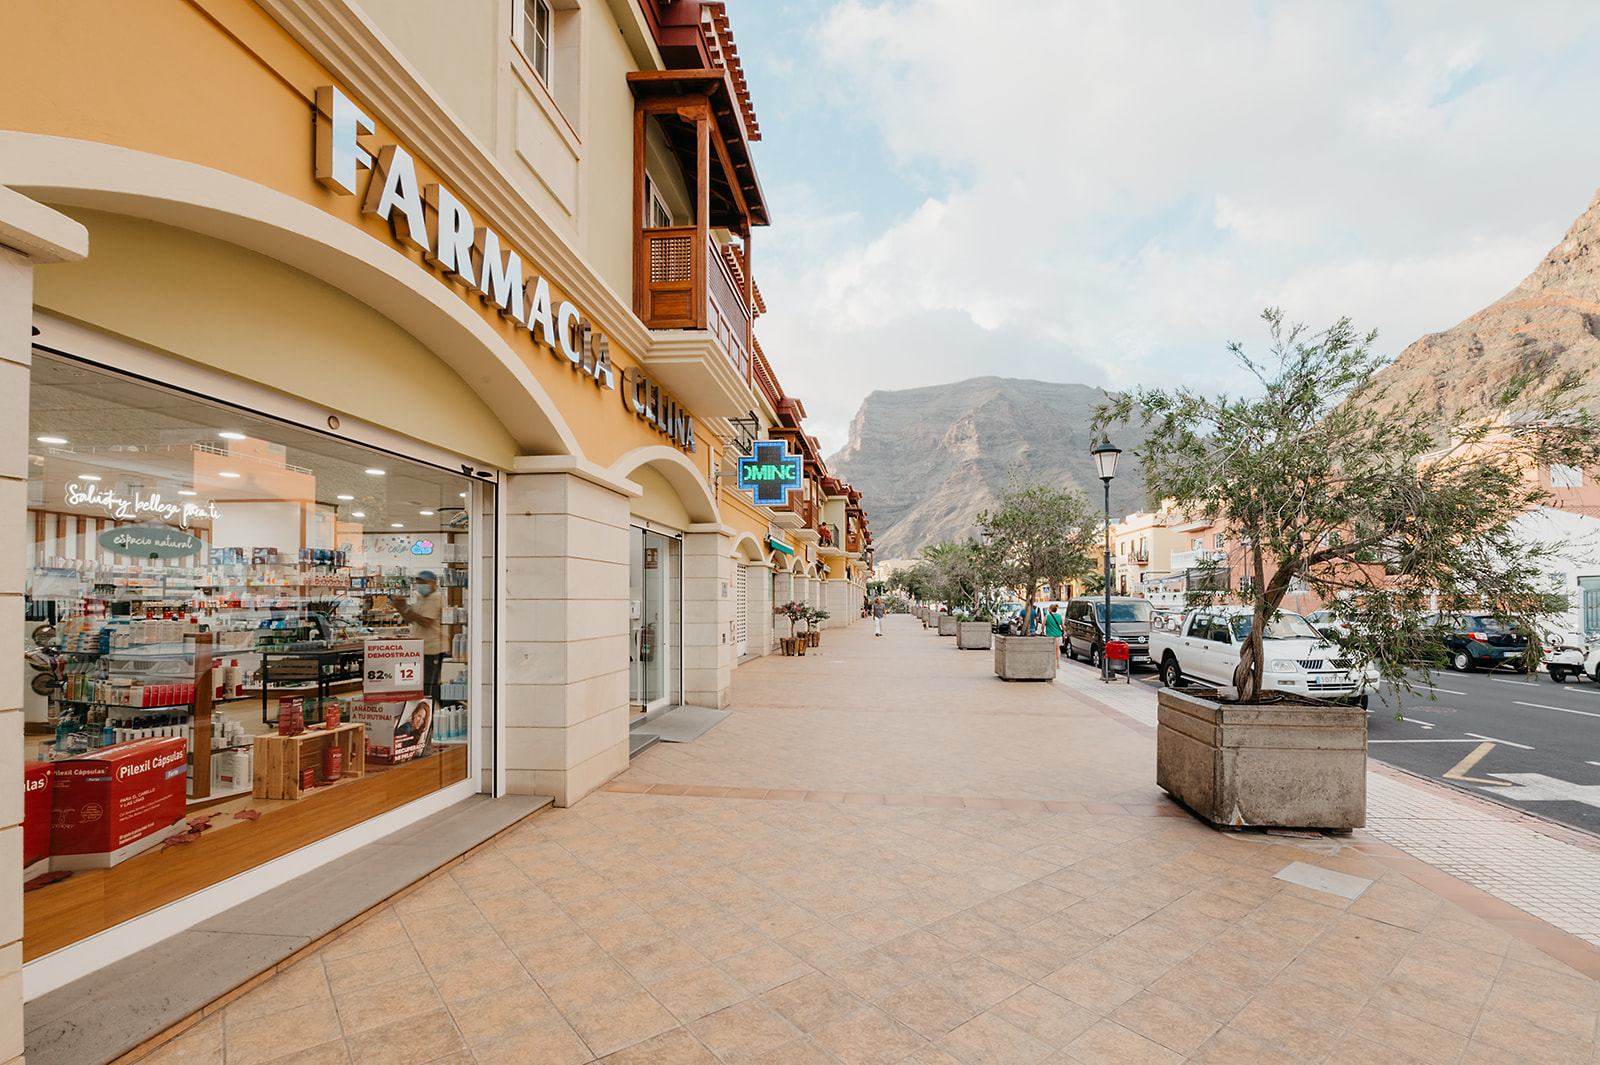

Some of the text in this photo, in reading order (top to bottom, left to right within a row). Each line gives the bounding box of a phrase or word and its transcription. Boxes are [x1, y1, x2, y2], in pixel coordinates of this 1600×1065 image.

[315, 85, 696, 453] FARMACIA CELINA
[69, 484, 114, 509] Salud
[113, 497, 132, 518] y
[135, 492, 181, 519] belleza
[113, 533, 193, 549] espacio natural
[367, 670, 393, 680] 82%
[400, 669, 414, 678] 12
[74, 768, 105, 776] Cápsulas
[120, 750, 184, 779] Pilexil Cápsulas
[23, 778, 45, 792] las
